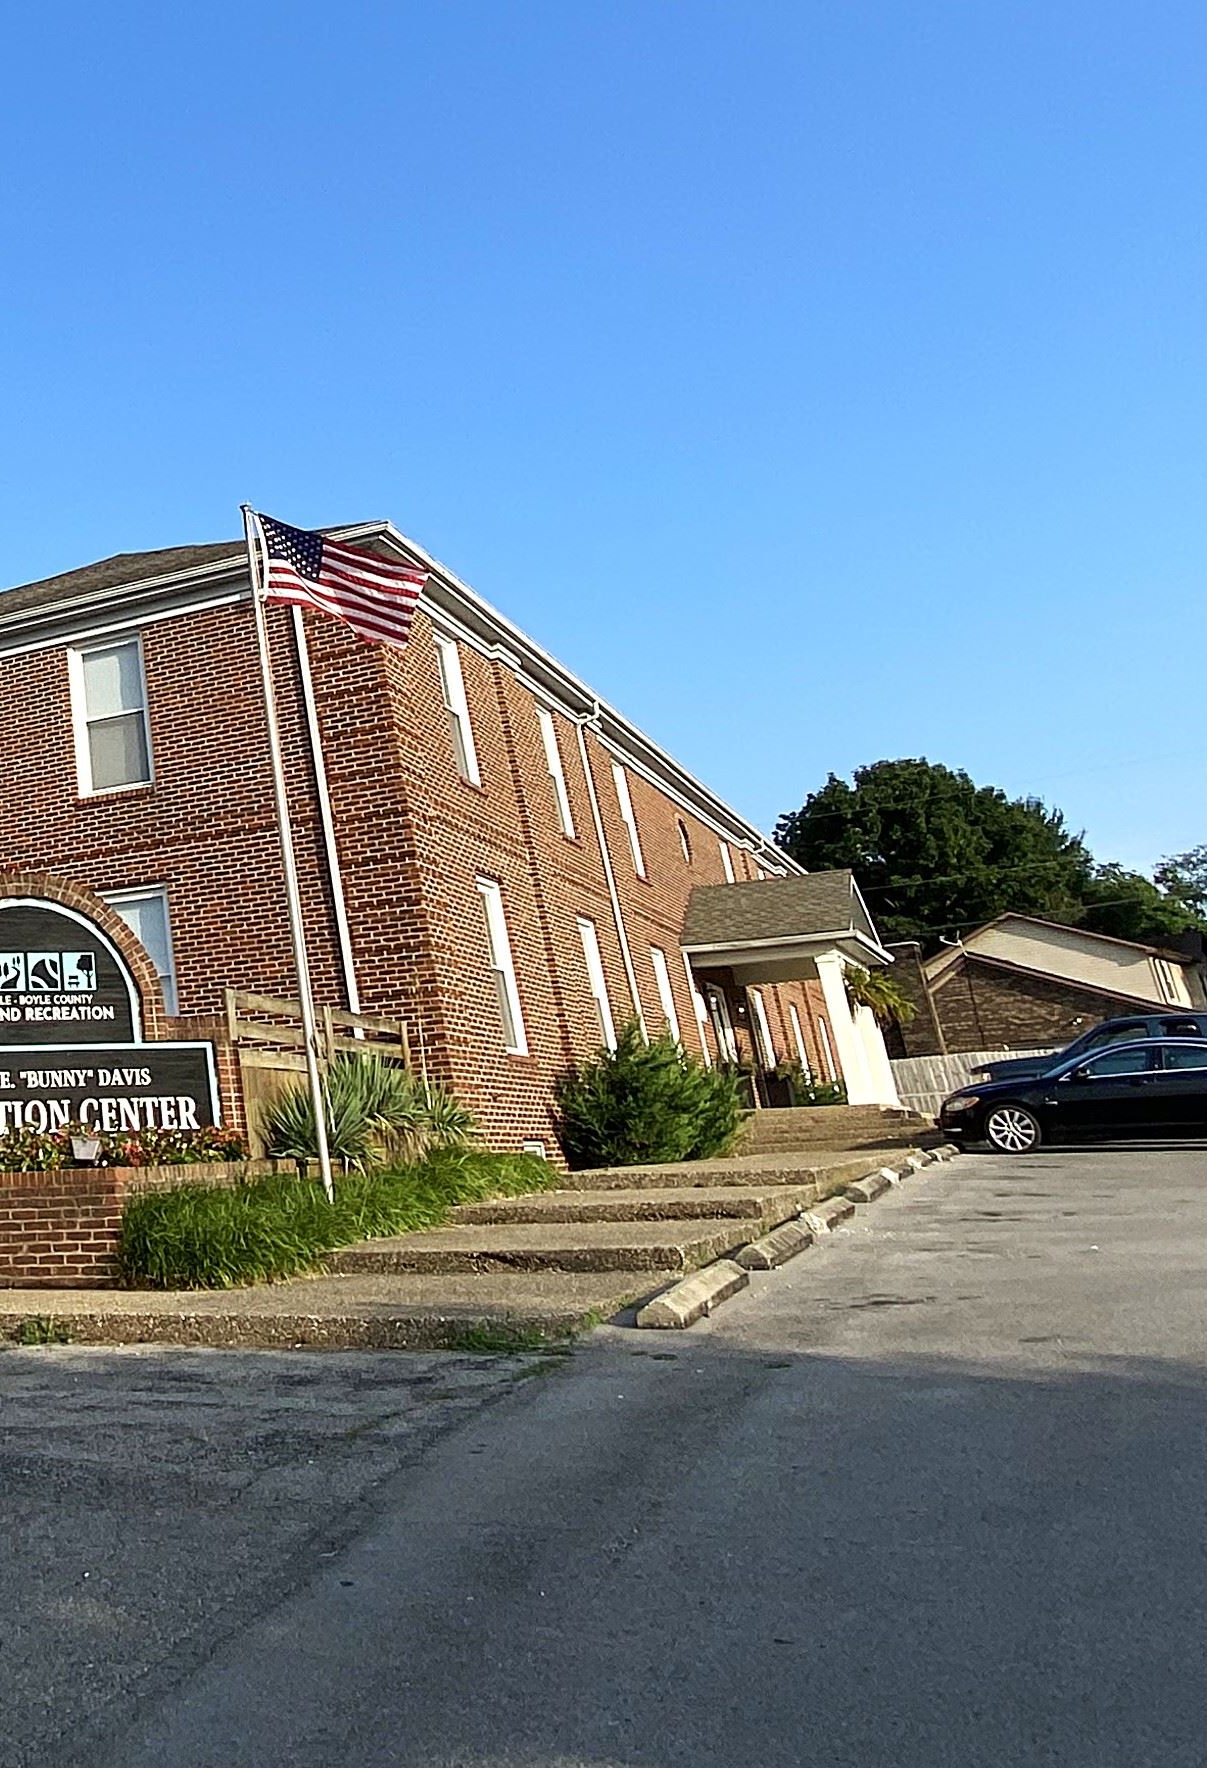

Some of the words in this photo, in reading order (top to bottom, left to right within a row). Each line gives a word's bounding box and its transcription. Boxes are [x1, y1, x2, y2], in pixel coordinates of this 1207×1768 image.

[19, 994, 51, 1006] BOYLE
[53, 994, 93, 1005] COUNTY
[25, 1005, 115, 1021] RECREATION
[0, 1071, 16, 1089] E.
[19, 1069, 94, 1088] "BUNNY"
[97, 1068, 152, 1087] DAVIS
[79, 1096, 201, 1133] CENTER
